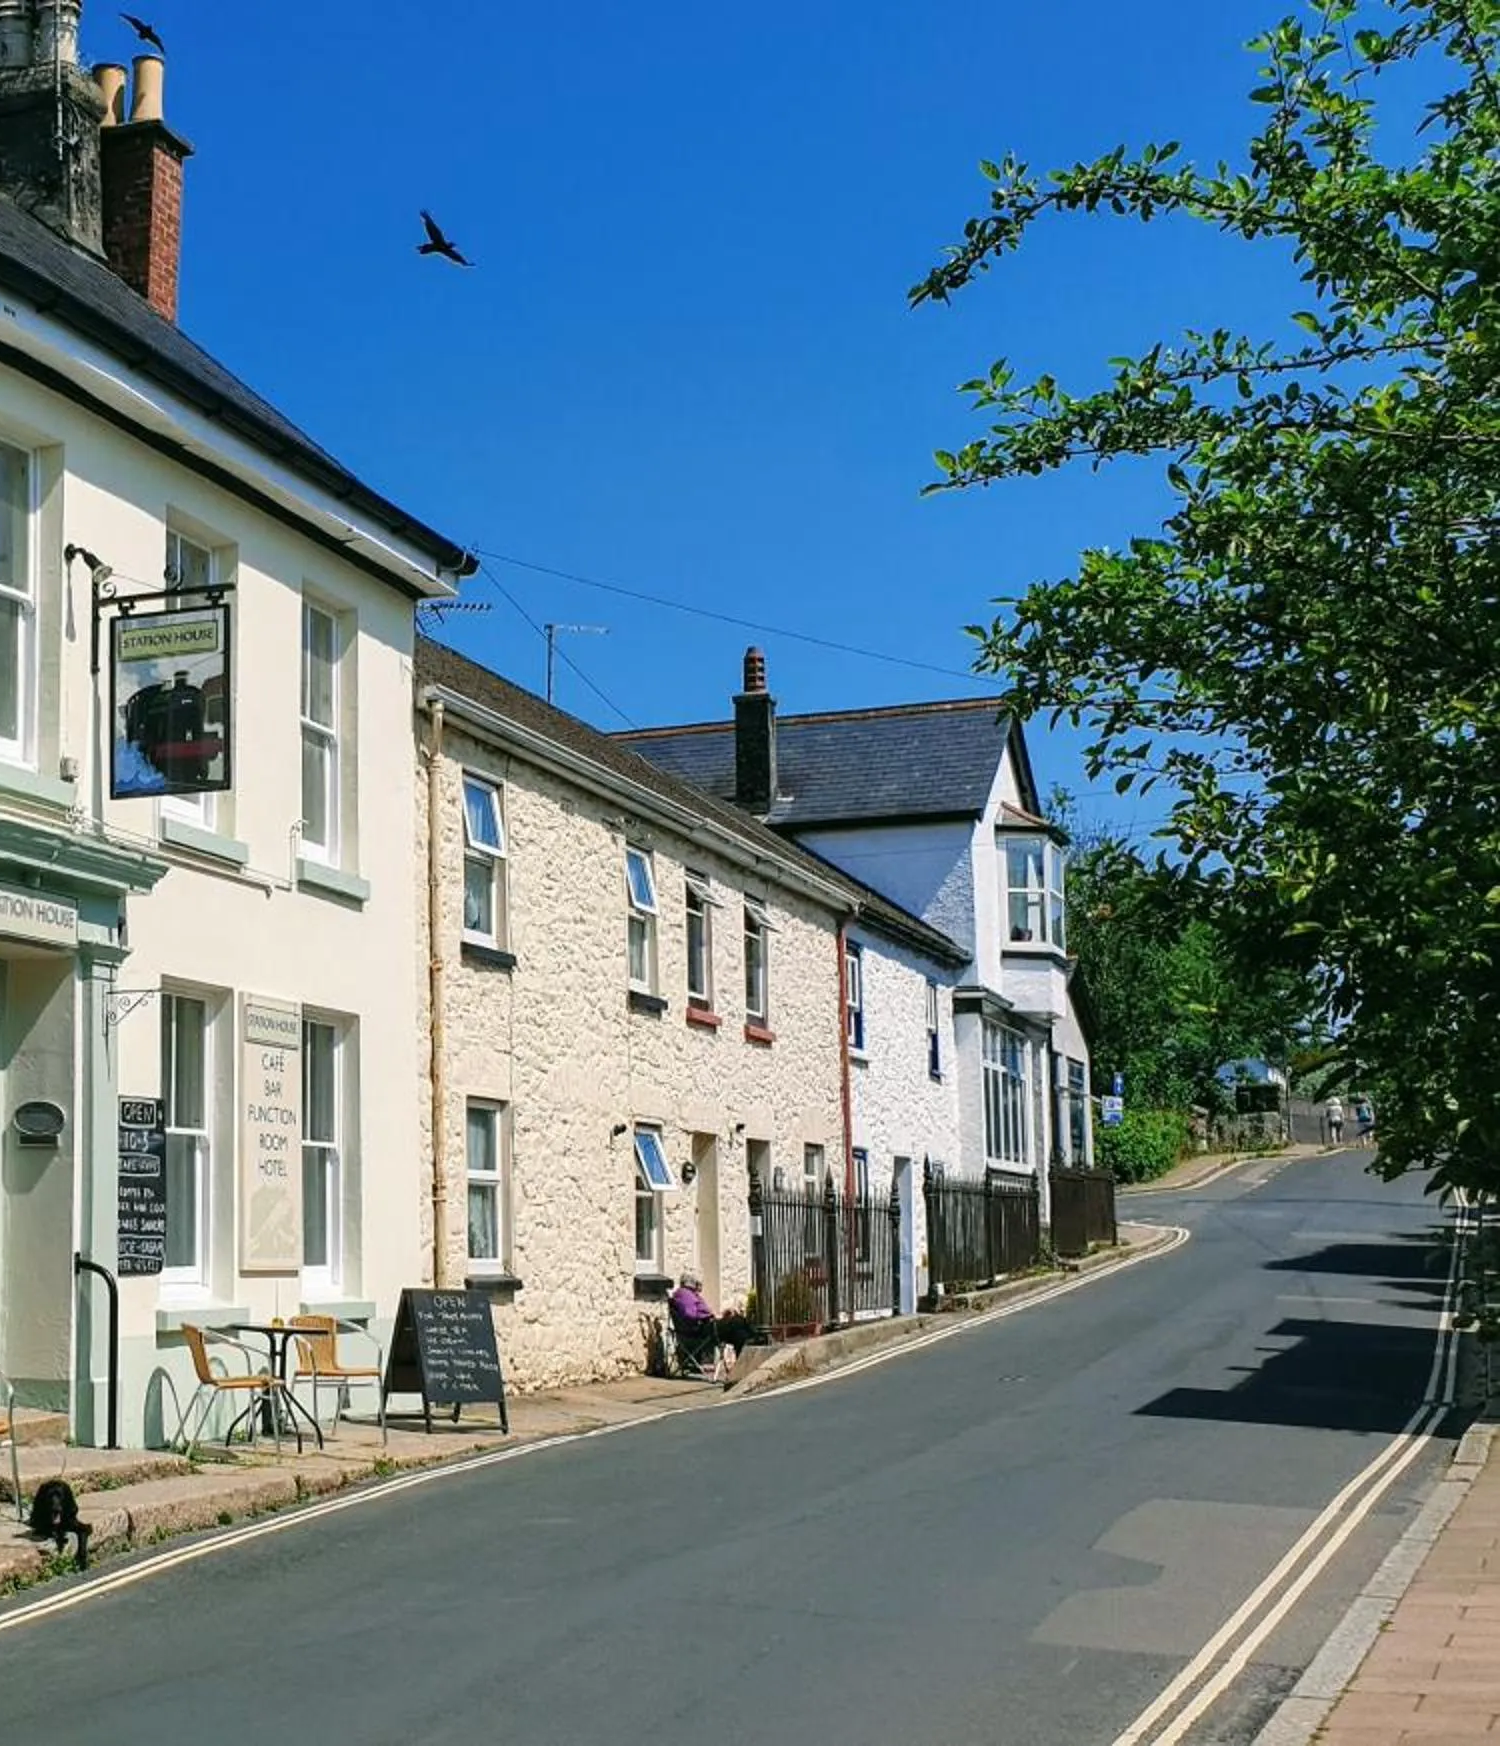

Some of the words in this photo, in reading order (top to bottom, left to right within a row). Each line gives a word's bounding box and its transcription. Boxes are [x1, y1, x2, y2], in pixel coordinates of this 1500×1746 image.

[121, 633, 172, 650] STATION
[175, 627, 215, 642] HOUSE
[36, 903, 75, 929] HOUSE
[249, 1013, 275, 1031] STATION
[276, 1018, 297, 1034] HOUSE
[261, 1050, 286, 1073] CAFÉ
[264, 1078, 283, 1097] BAR
[124, 1103, 154, 1122] OPEN
[248, 1103, 297, 1126] FUNCTION
[259, 1132, 288, 1152] ROOM
[259, 1160, 288, 1178] HOTEL
[433, 1294, 467, 1309] OPEN
